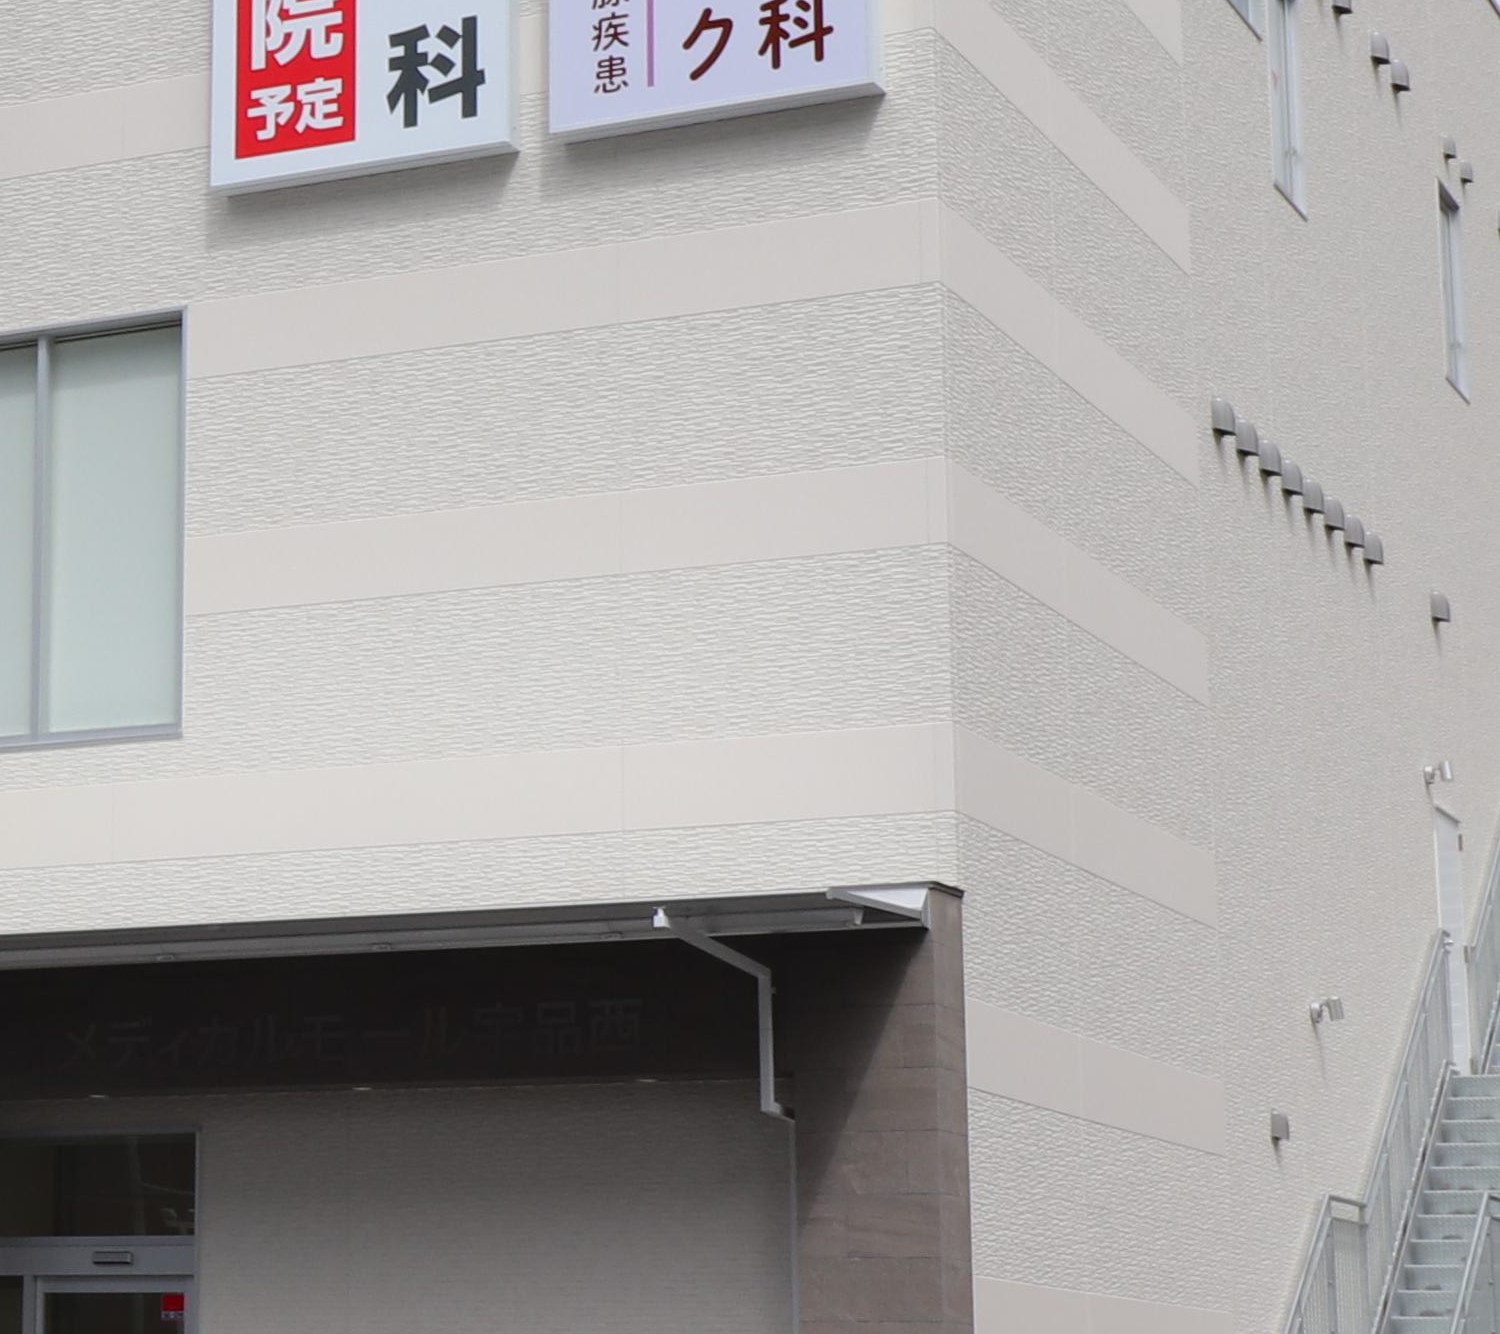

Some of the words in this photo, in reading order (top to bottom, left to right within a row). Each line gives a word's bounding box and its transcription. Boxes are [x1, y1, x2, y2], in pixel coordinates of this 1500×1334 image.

[62, 999, 643, 1070] メディカルモール宇品西
